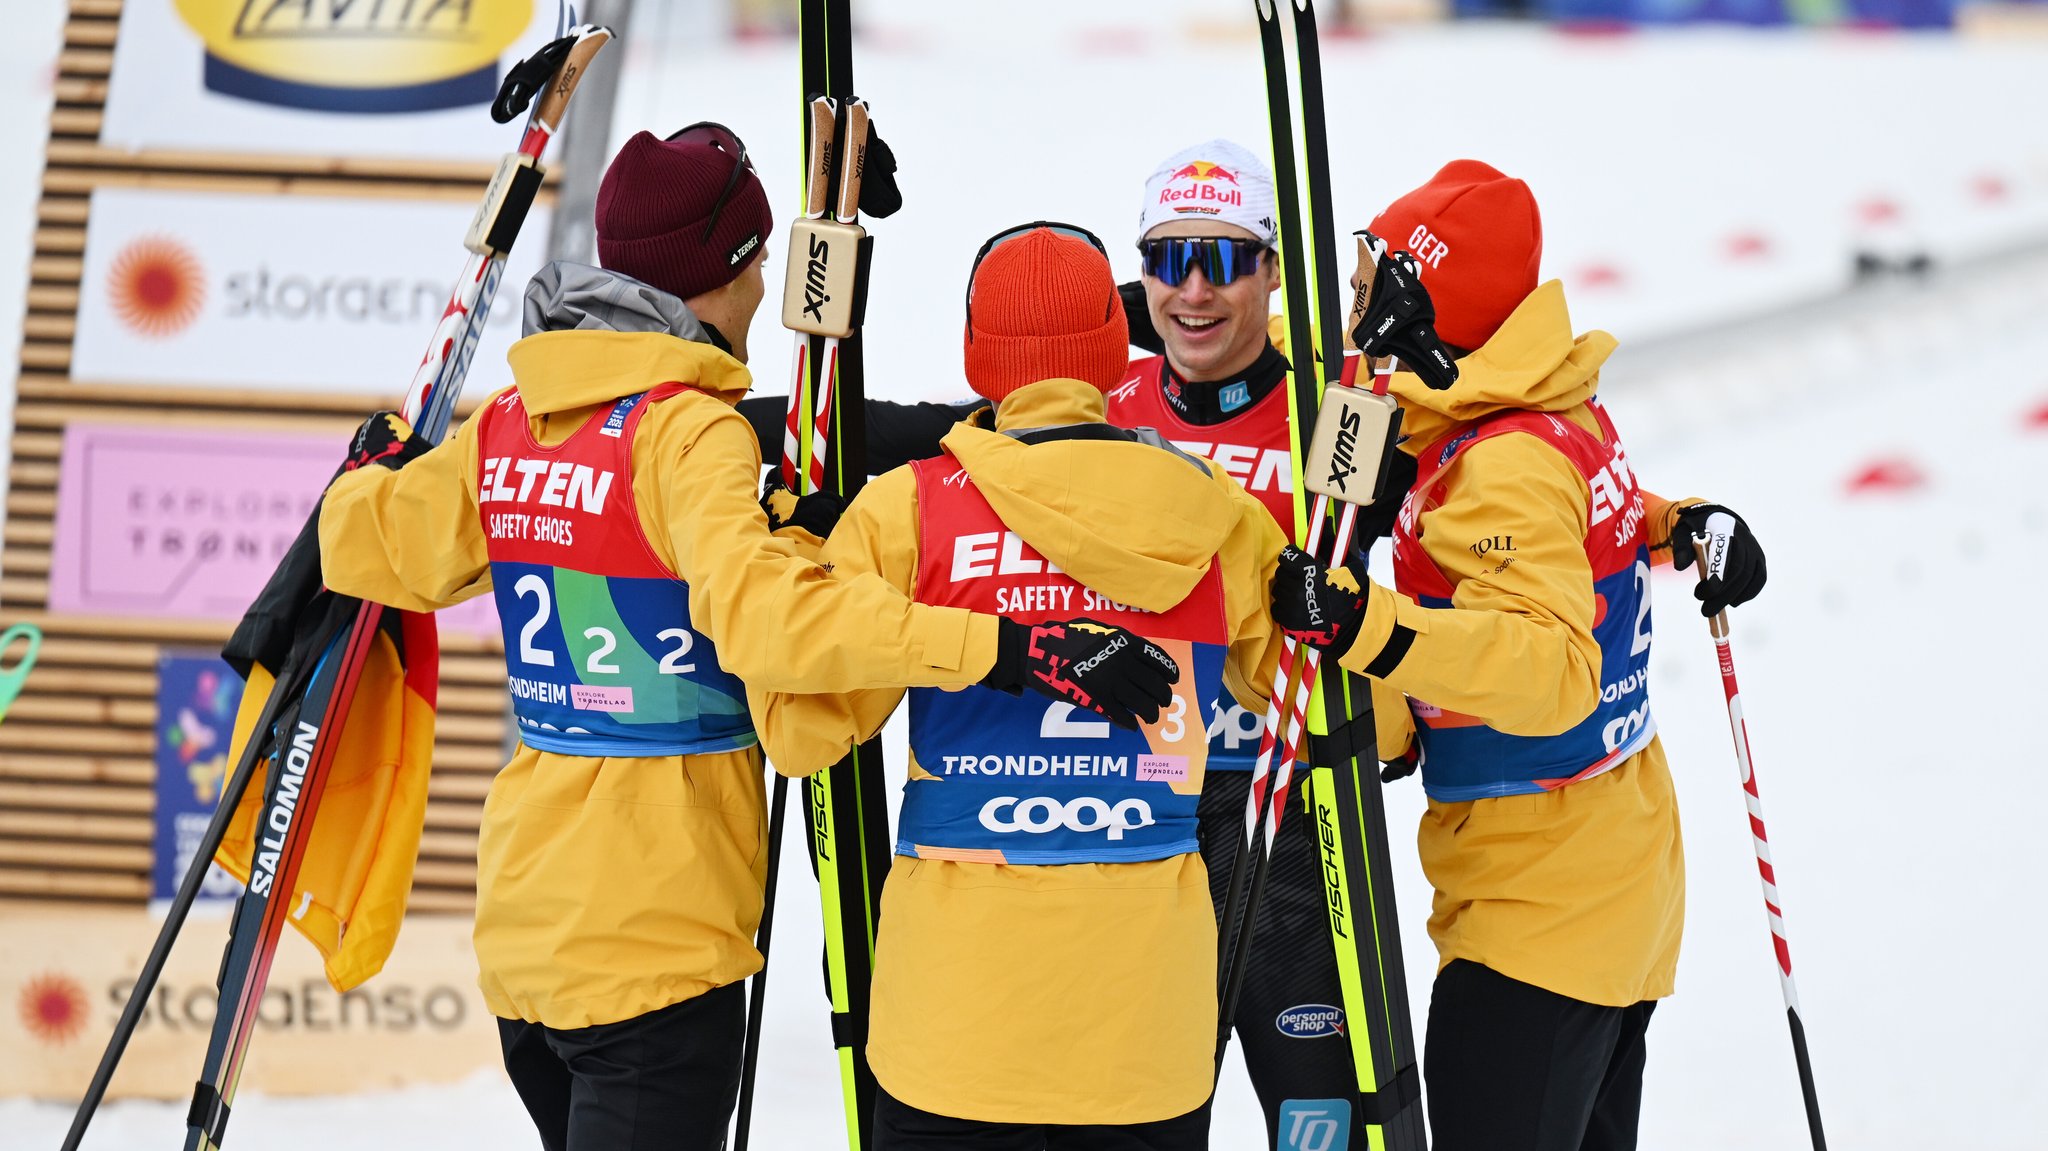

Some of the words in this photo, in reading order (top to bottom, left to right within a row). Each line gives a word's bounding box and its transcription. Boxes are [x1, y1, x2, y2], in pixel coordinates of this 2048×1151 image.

[821, 141, 832, 177] swix
[1160, 184, 1198, 207] Red
[1200, 185, 1242, 207] Bull
[737, 234, 759, 259] TERREX
[1407, 223, 1449, 270] GER
[803, 232, 831, 325] swix
[1353, 279, 1368, 319] swix
[1377, 315, 1396, 336] swix
[1431, 349, 1451, 370] swix
[1326, 402, 1362, 495] swix
[479, 456, 615, 516] ELTEN
[489, 512, 531, 541] SAFETY
[533, 515, 574, 547] SHOES
[995, 585, 1075, 614] SAFETY
[513, 573, 555, 668] 2
[583, 626, 620, 675] 2
[656, 627, 696, 675] 2
[1159, 693, 1187, 743] 3
[942, 755, 1128, 777] TRONDHEIM
[250, 720, 319, 898] SALOMON
[978, 796, 1156, 841] coop
[1318, 804, 1348, 939] FISCHER
[1281, 1010, 1339, 1027] personal
[1293, 1020, 1325, 1032] shop
